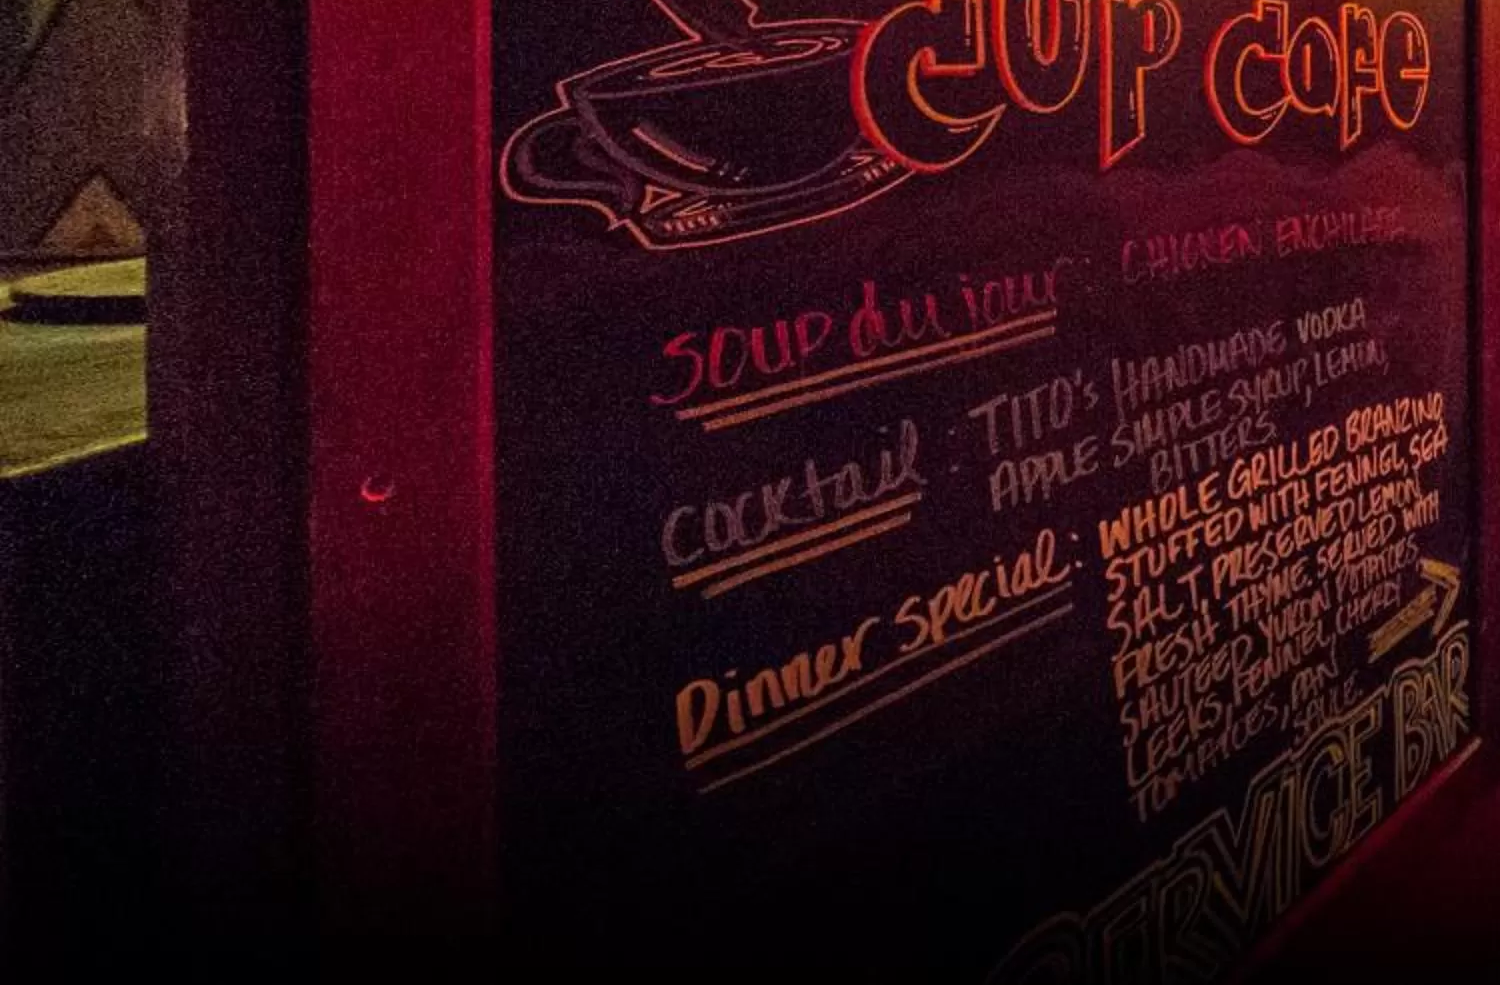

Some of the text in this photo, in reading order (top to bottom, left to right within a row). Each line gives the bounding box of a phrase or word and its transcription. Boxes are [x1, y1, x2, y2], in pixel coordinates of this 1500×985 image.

[1111, 320, 1287, 425] HANDMADE
[1297, 297, 1367, 345] VODKA
[988, 435, 1099, 511] APPLE
[1111, 391, 1221, 468] SIMPLE
[1100, 471, 1222, 561] WHOLE
[1228, 424, 1339, 501] GRILLED
[1105, 505, 1244, 603] STUFFED
[1249, 473, 1310, 532] WITH
[1408, 422, 1450, 470] SEA
[1107, 565, 1203, 665] SALT
[1211, 500, 1357, 600] PRESERVED
[1112, 597, 1220, 701] FRESH
[1317, 512, 1398, 581] SERVED
[1402, 490, 1440, 533] WITH
[675, 617, 880, 755] Dinner
[1388, 617, 1470, 805] BAR
